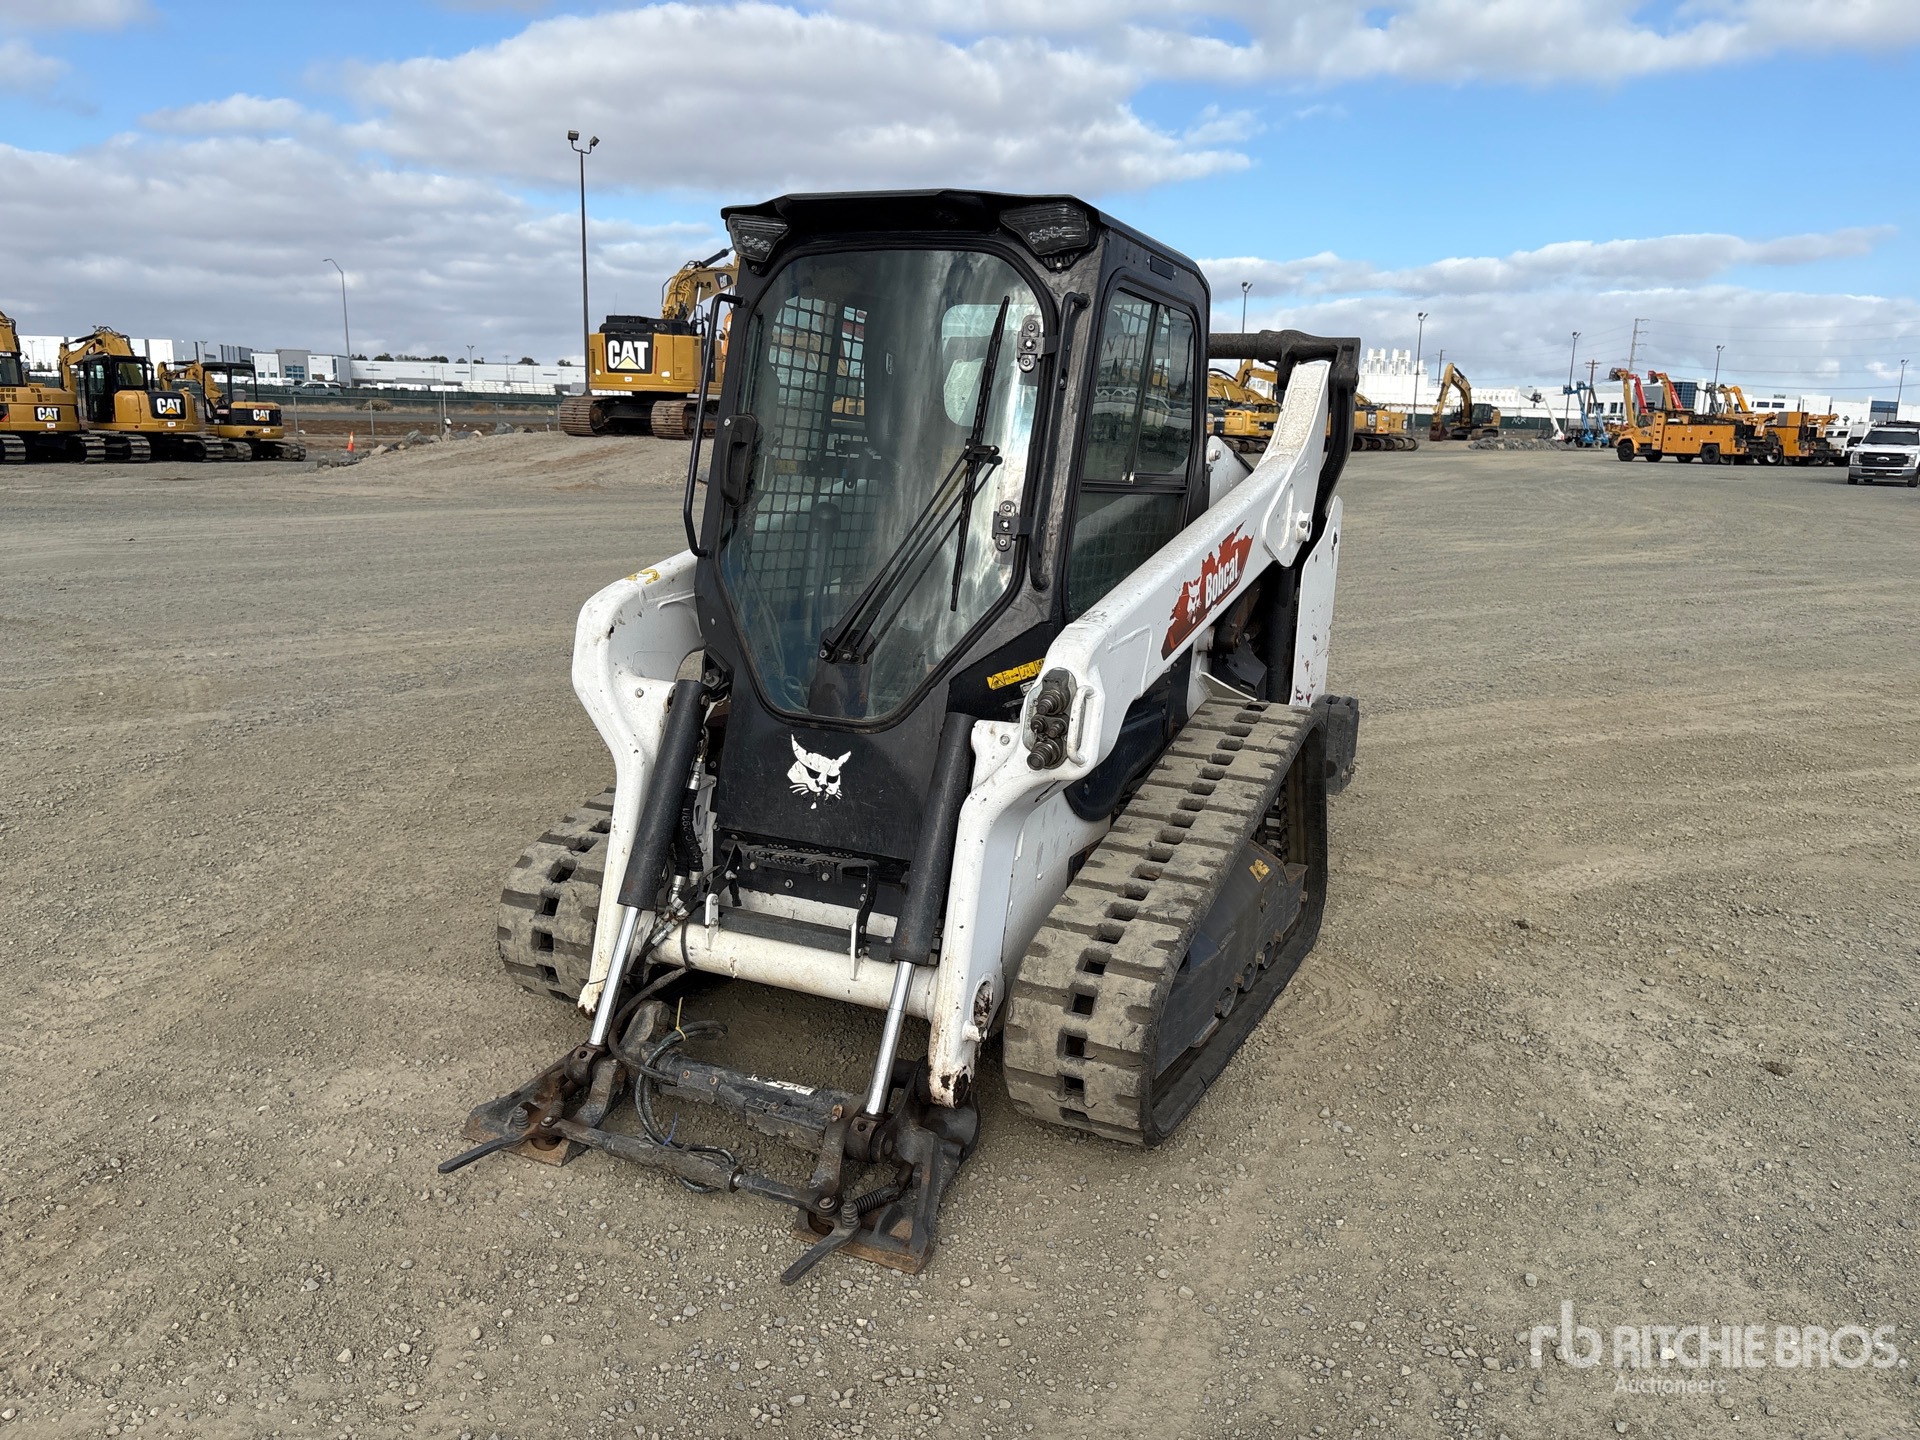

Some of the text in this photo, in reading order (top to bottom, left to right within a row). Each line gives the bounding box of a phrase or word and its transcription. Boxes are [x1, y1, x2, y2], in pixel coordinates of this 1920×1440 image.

[607, 340, 649, 370] CAT
[37, 407, 59, 421] CAT
[156, 398, 182, 415] CAT
[252, 409, 271, 422] CAT
[1205, 547, 1239, 610] Bobcat
